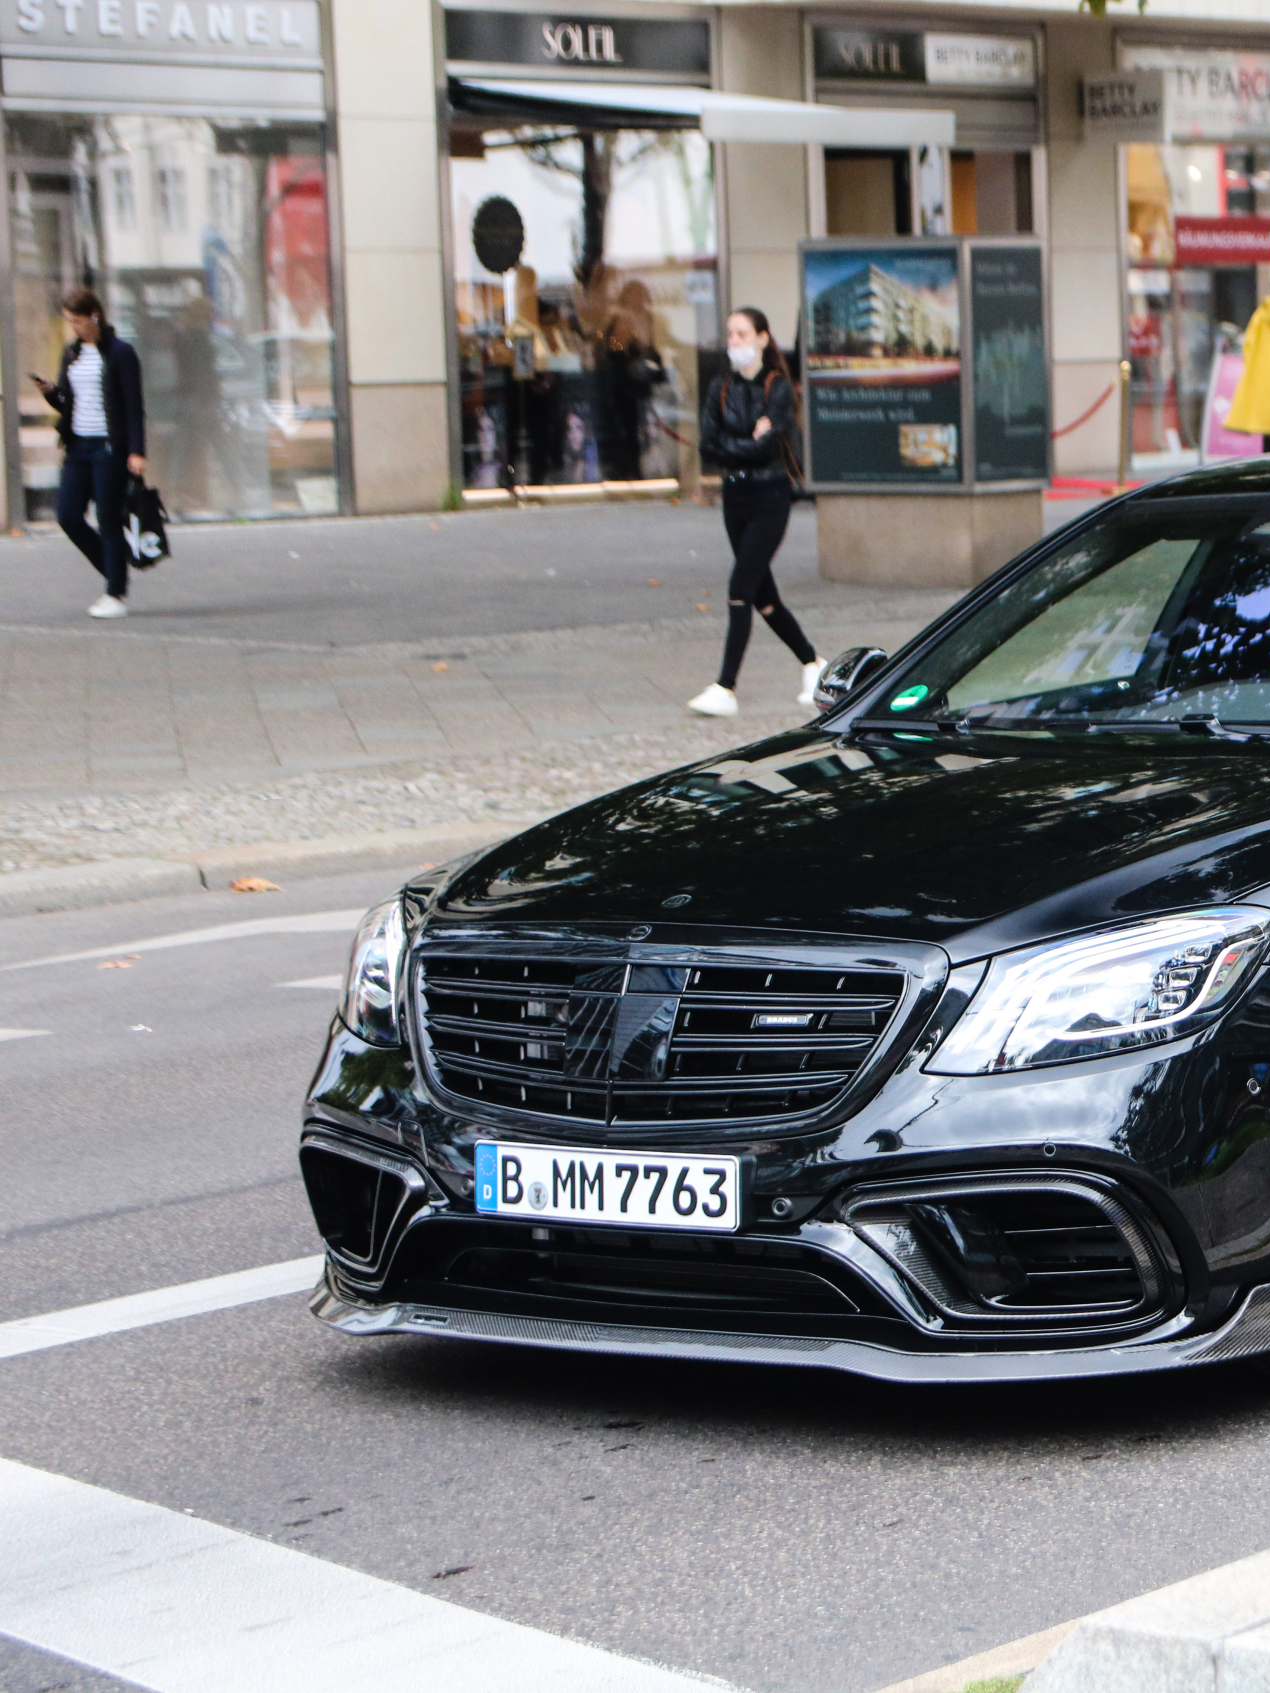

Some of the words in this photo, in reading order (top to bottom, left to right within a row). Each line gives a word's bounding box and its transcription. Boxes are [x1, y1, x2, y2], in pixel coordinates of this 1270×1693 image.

[17, 0, 302, 45] STEFANEL
[1088, 80, 1136, 98] BETTY
[766, 1016, 798, 1024] BRABUS
[483, 1184, 492, 1199] D
[501, 1155, 524, 1204] B
[552, 1158, 604, 1211] MM
[615, 1163, 728, 1218] 7763
